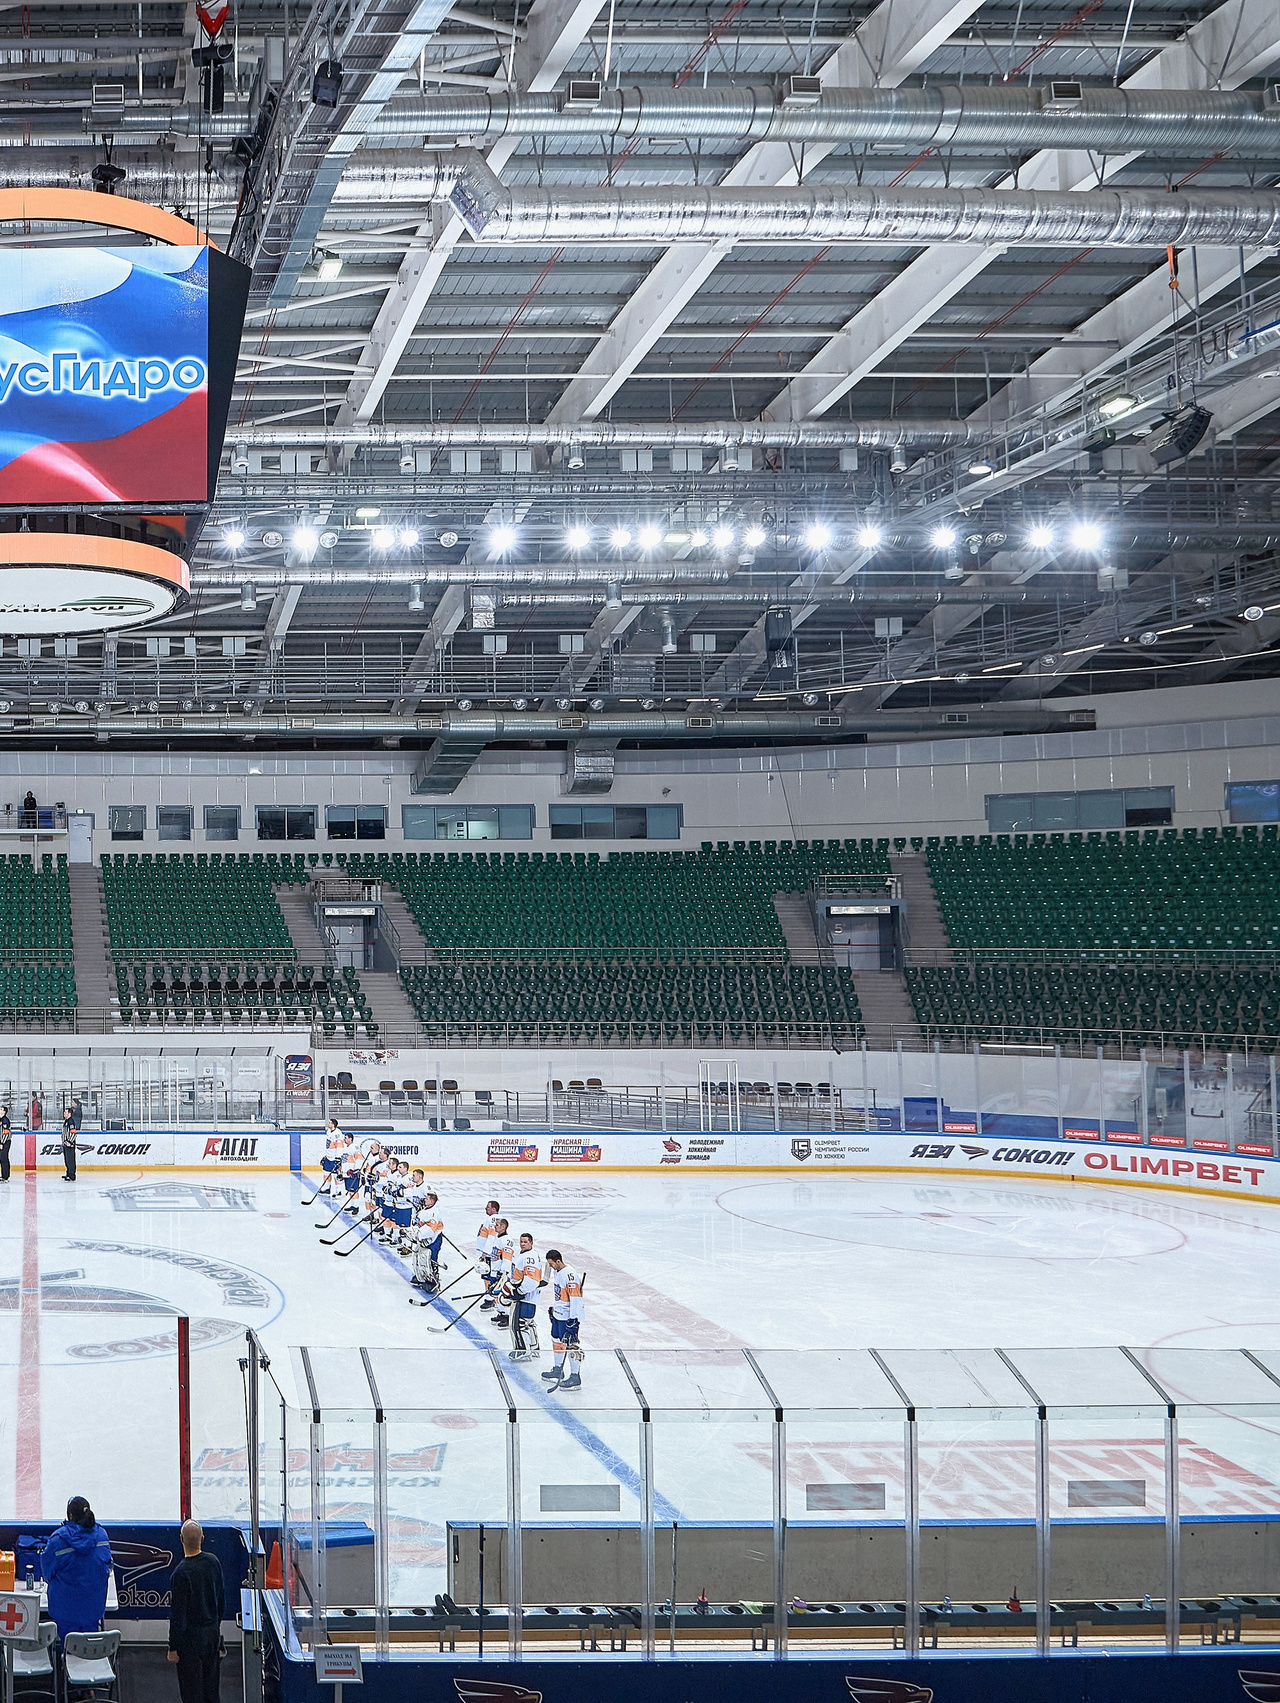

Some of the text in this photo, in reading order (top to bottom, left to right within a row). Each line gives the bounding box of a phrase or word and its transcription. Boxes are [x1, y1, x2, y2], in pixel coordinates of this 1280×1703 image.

[490, 1138, 519, 1146] КРАСНАЯ
[553, 1138, 582, 1146] КРАСНАЯ
[1108, 1134, 1142, 1142] OLIMPBET
[1151, 1137, 1185, 1145] OLIMPBET
[96, 1143, 151, 1155] СОКОЛ!
[220, 1138, 259, 1156] АГАТ
[1194, 1141, 1228, 1149] OLIMPBET
[1237, 1145, 1271, 1153] OLIMPBET
[489, 1146, 520, 1154] МАШИНА
[552, 1146, 583, 1154] МАШИНА
[992, 1147, 1075, 1166] СОКОЛ!
[1084, 1153, 1265, 1186] OLIMPBET
[567, 1273, 575, 1281] 15
